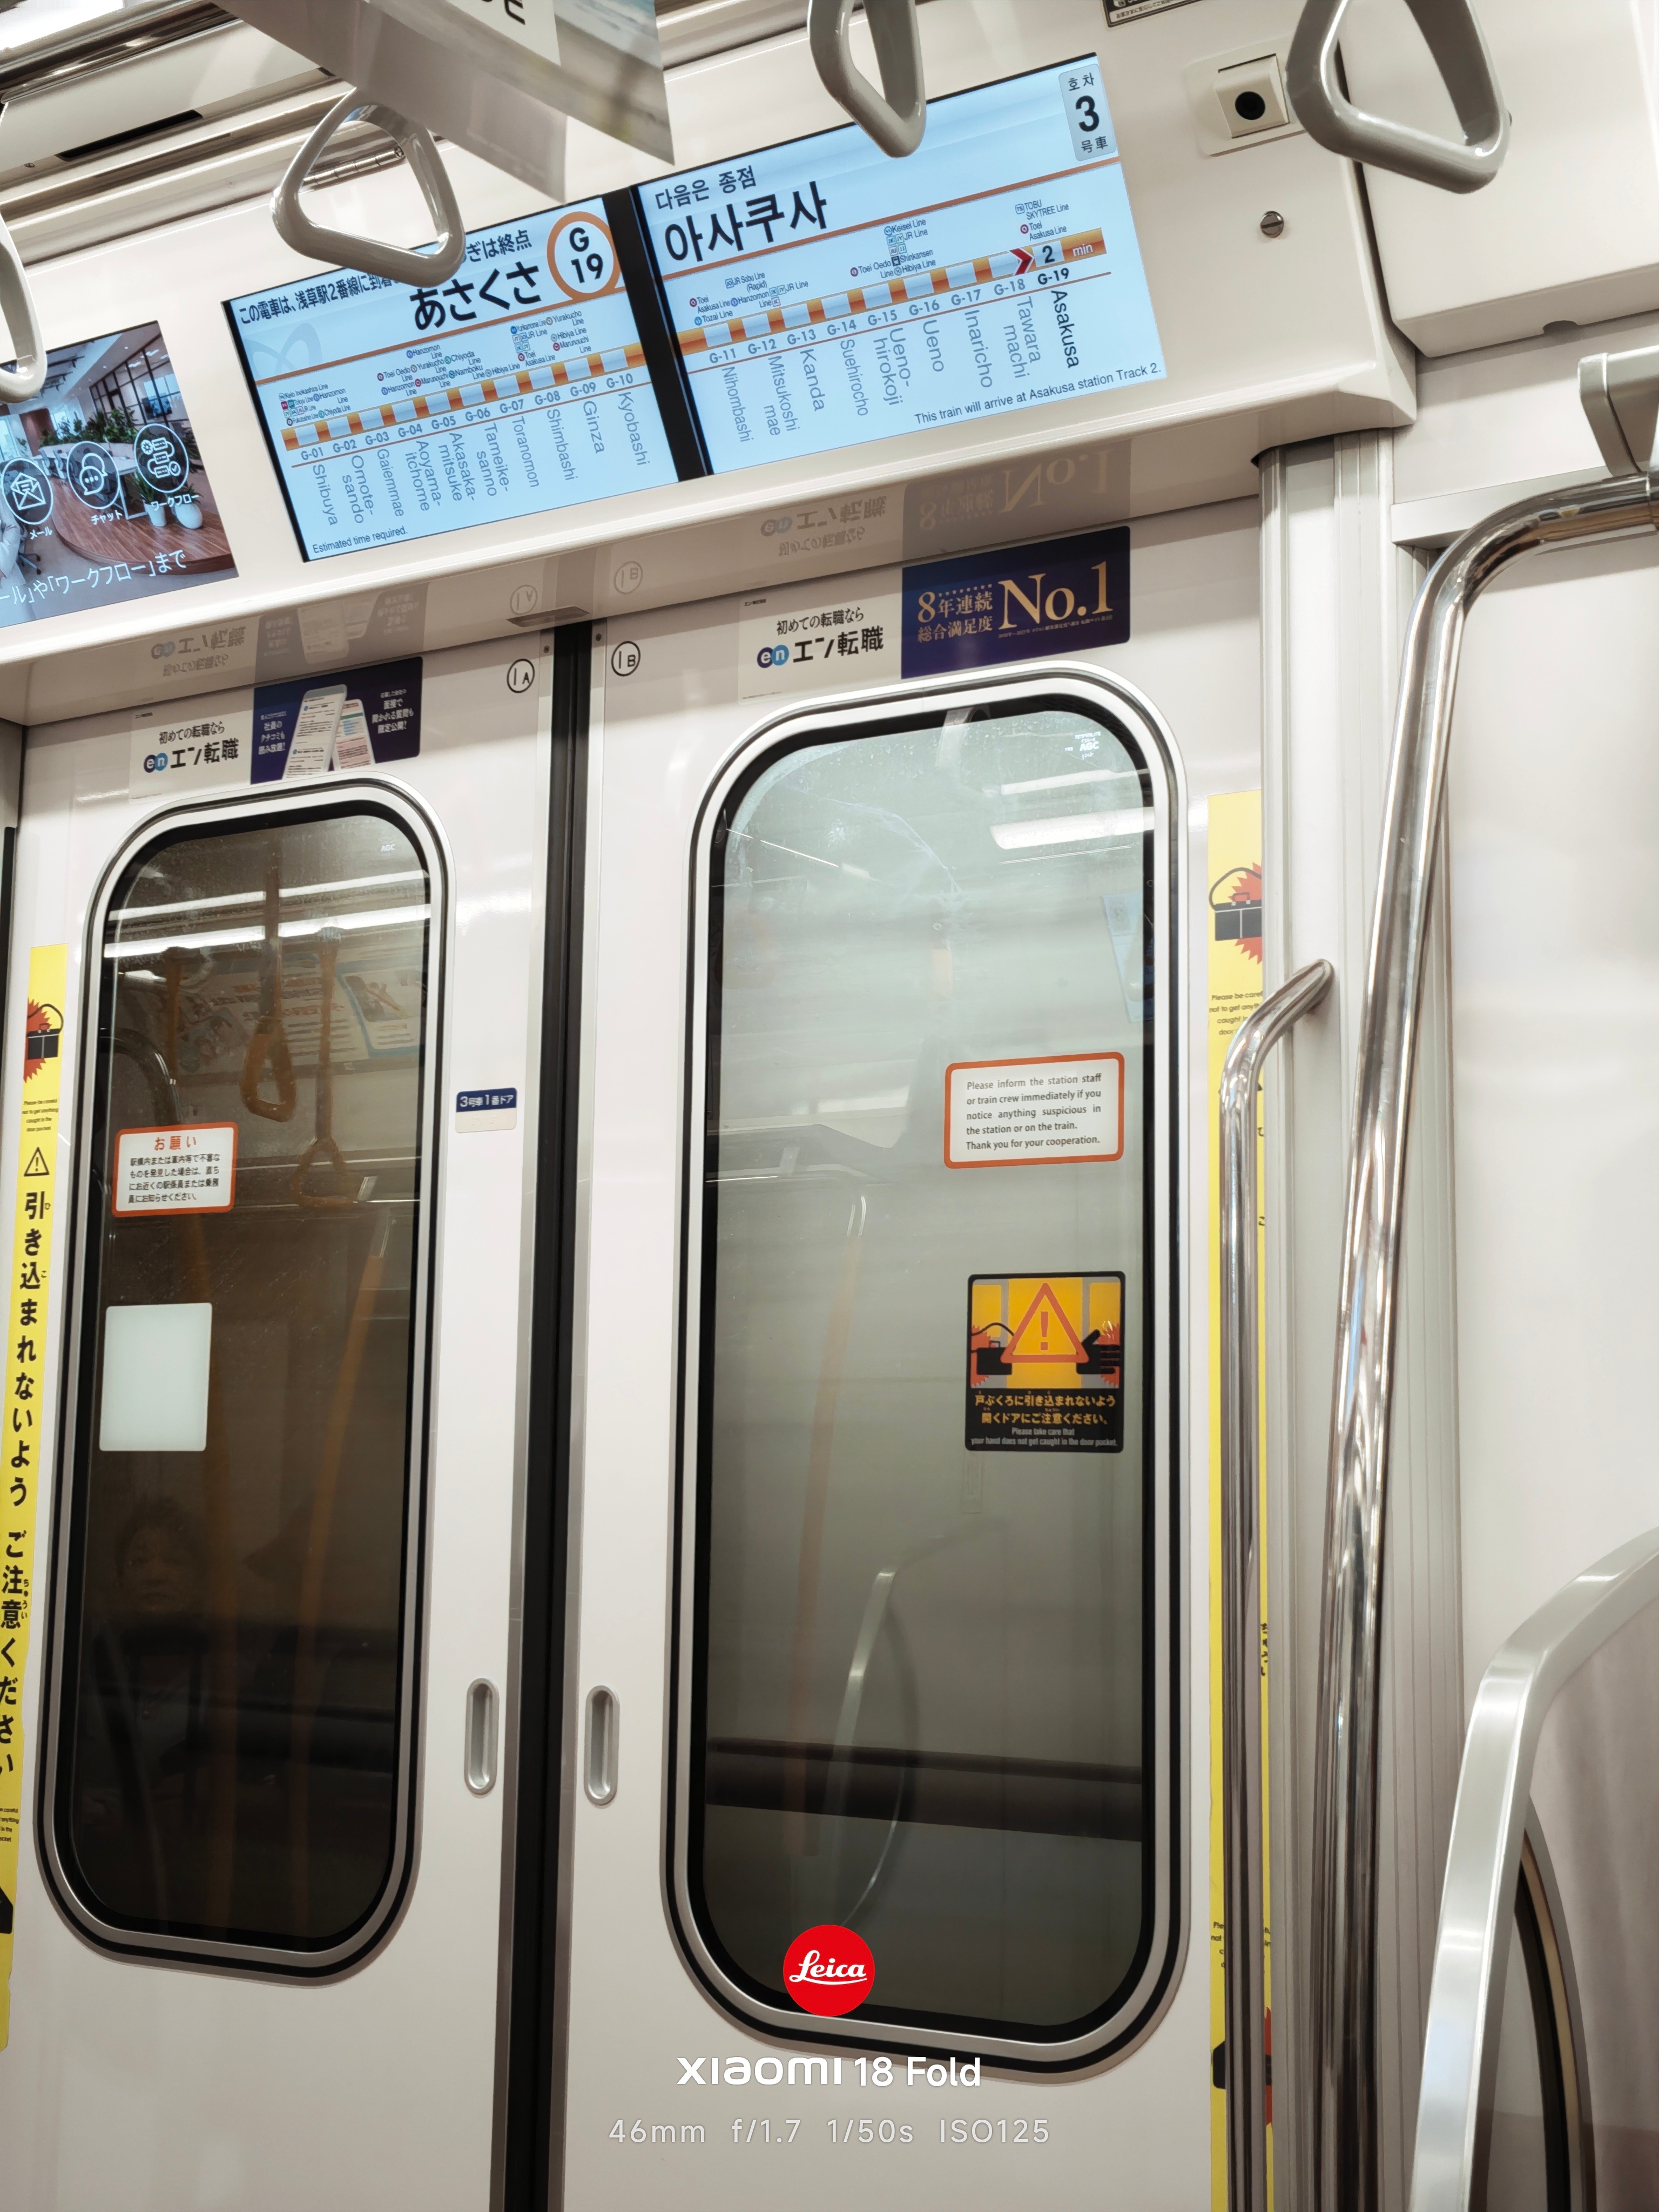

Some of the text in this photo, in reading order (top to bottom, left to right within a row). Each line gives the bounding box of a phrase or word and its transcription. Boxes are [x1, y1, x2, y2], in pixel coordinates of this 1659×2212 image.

[1077, 95, 1101, 132] 3
[654, 165, 757, 212] 다음은 종점
[1024, 200, 1042, 211] TOBU
[1026, 204, 1069, 220] SKYTREE Line
[664, 180, 828, 264] 아사쿠사
[893, 219, 927, 233] Keisei Line
[1029, 221, 1043, 231] Toei
[1030, 226, 1067, 241] Asakusa Line
[463, 230, 532, 263] ぎは終点
[569, 227, 589, 252] G
[903, 229, 928, 241] JR Line
[900, 249, 934, 263] Shinkansen
[1042, 243, 1093, 264] 2 min
[571, 254, 604, 285] 19
[1038, 268, 1069, 285] G-19
[409, 261, 542, 331] あさくさ
[785, 280, 809, 292] JR Line
[951, 289, 981, 306] G-17
[994, 279, 1026, 295] G-18
[702, 309, 733, 323] Tozai Line
[867, 310, 898, 326] G-15
[909, 300, 940, 316] G-16
[787, 329, 817, 345] G-13
[827, 320, 857, 335] G-14
[1017, 296, 1041, 363] Tawara
[1051, 290, 1079, 368] Asakusa
[709, 348, 737, 364] G-11
[748, 339, 777, 355] G-12
[890, 328, 911, 387] Ueno-
[922, 320, 945, 372] Ueno
[965, 309, 993, 388] Inaricho
[1003, 325, 1029, 378] machi
[606, 373, 633, 388] G-10
[800, 349, 825, 412] Kanda
[840, 339, 869, 416] Suehirocho
[873, 338, 903, 406] hirokoji
[535, 390, 561, 405] G-08
[570, 382, 596, 397] G-09
[768, 355, 800, 431] Mitsukoshi
[914, 362, 1162, 425] This train will arrive at Asakusa station Track 2.
[466, 408, 490, 422] G-06
[500, 399, 524, 414] G-07
[721, 367, 754, 442] Nihombashi
[398, 423, 423, 438] G-04
[431, 416, 456, 430] G-05
[583, 401, 605, 454] Ginza
[618, 392, 650, 466] Kyobashi
[764, 405, 780, 436] mae
[333, 440, 357, 453] G-02
[365, 431, 389, 446] G-03
[547, 409, 578, 481] Shimbashi
[301, 447, 324, 461] G-01
[484, 423, 509, 492] Tameike-
[512, 416, 539, 487] Toranomon
[416, 441, 441, 507] Aoyama-
[439, 444, 462, 502] mitsuke
[449, 432, 475, 501] Akasaka-
[477, 451, 497, 497] sanno
[352, 455, 374, 515] Omote-
[377, 449, 404, 516] Gaiemmae
[405, 453, 430, 511] itchome
[151, 494, 200, 512] ワークフロー
[313, 464, 338, 525] Shibuya
[342, 475, 364, 523] sando
[90, 509, 124, 525] チャット
[29, 527, 52, 540] メール
[313, 525, 408, 553] Estimated time required.
[918, 591, 993, 623] 8年連続
[998, 561, 1113, 631] No.1
[777, 607, 864, 636] 初めての転職なら
[918, 615, 993, 643] 総合満足度
[793, 625, 884, 663] エン転職
[159, 721, 225, 745] 初めての転職なら
[170, 738, 239, 768] エン転職
[1080, 741, 1100, 751] AGC
[967, 1073, 1102, 1090] Please inform the station staff
[977, 1095, 997, 1104] train
[999, 1095, 1019, 1103] crew
[1021, 1090, 1075, 1102] immediately
[1077, 1089, 1084, 1098] if
[1085, 1090, 1102, 1100] you
[966, 1104, 1101, 1121] notice anything suspicious in
[966, 1121, 1078, 1135] the station or on the train.
[154, 1135, 197, 1151] お願い
[966, 1134, 1101, 1151] Thank you for your cooperation.
[10, 1191, 45, 1507] 引き込まれないよう
[975, 1394, 1116, 1407] 戸ぶくろに引き込まれないよう
[981, 1412, 1108, 1425] 開くドアにご注意ください。
